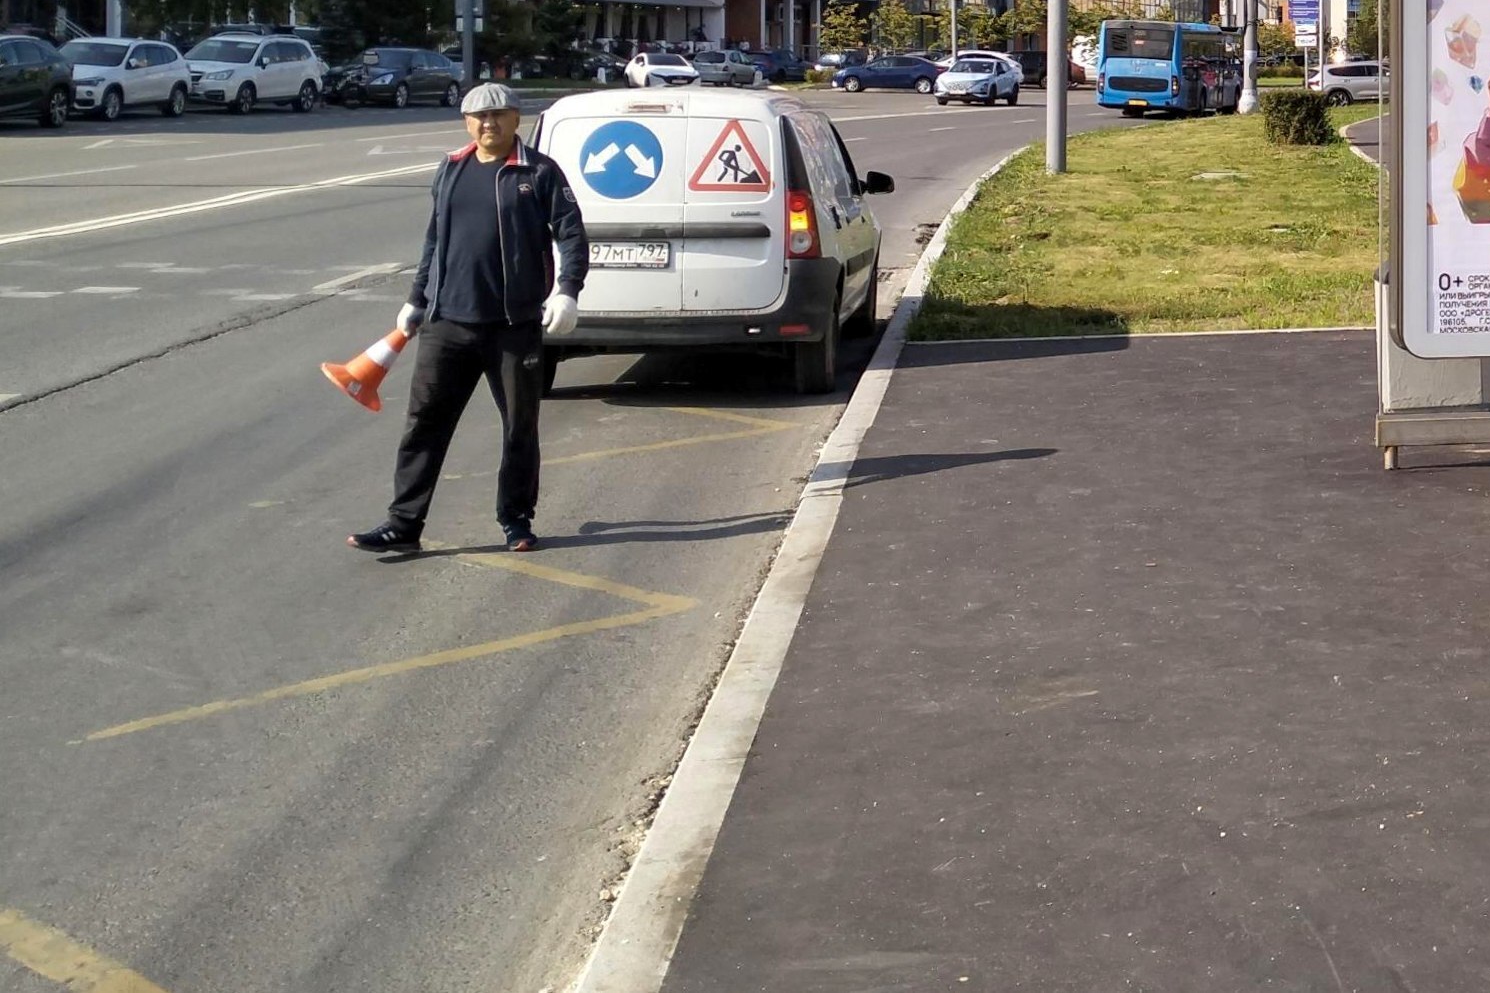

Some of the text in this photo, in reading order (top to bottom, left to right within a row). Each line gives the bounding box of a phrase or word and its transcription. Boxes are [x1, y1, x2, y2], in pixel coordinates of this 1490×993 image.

[588, 244, 664, 261] 97МТ 797
[1438, 273, 1464, 291] 0+
